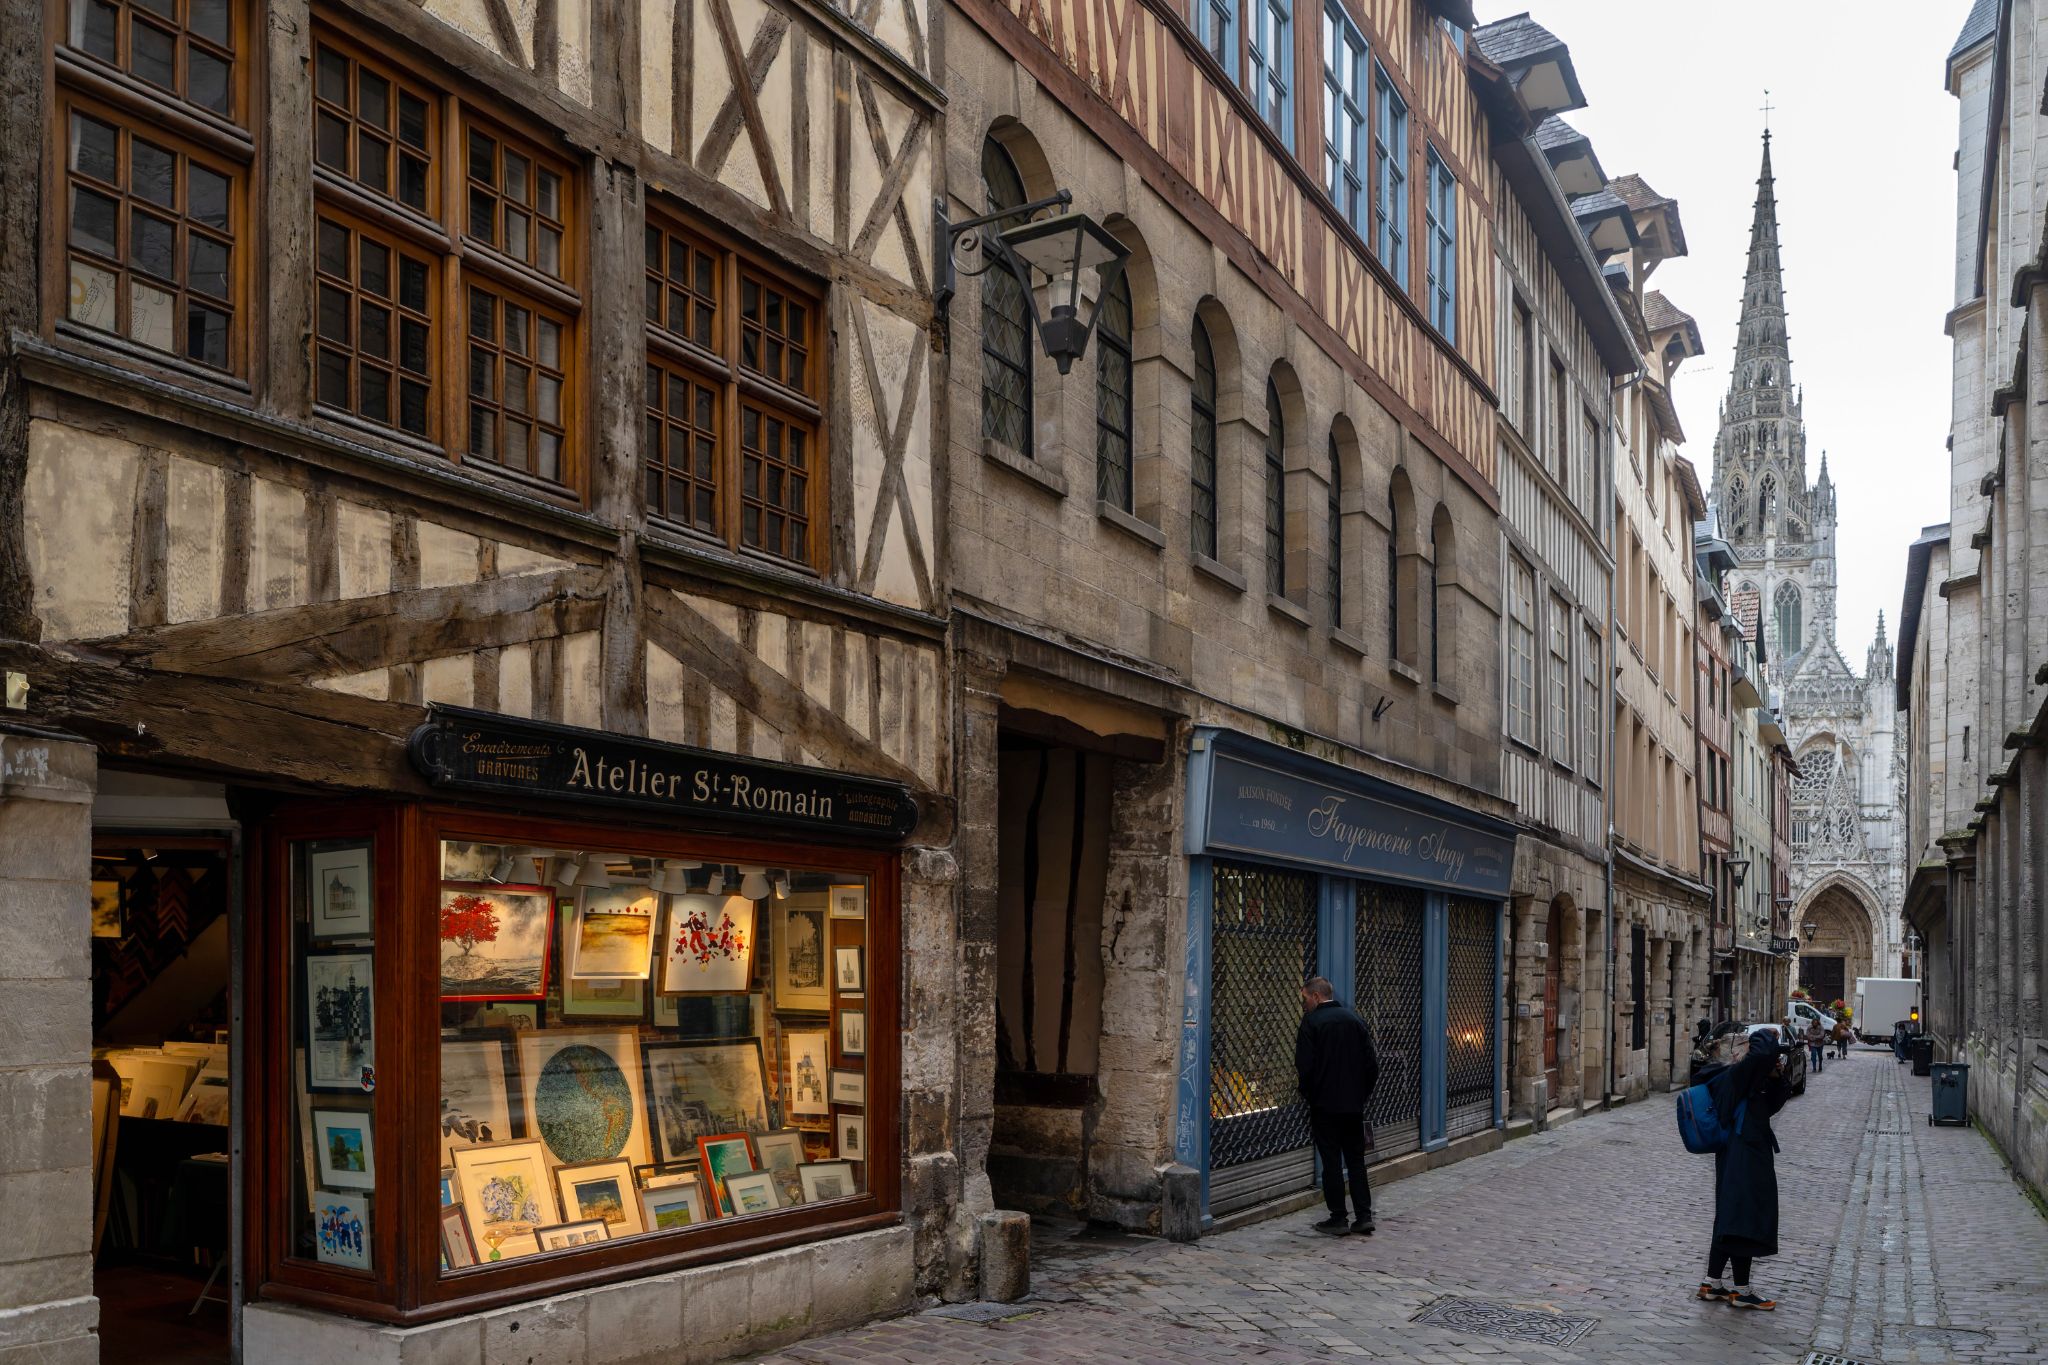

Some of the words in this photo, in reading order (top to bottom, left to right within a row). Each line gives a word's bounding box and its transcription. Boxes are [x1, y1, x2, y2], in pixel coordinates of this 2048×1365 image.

[462, 731, 552, 756] Encadrements
[477, 759, 539, 781] GRAVURES
[567, 747, 682, 798] Atelier
[1237, 786, 1265, 801] MAISON
[1307, 795, 1412, 863] Fayencerie
[1418, 828, 1465, 881] Augy
